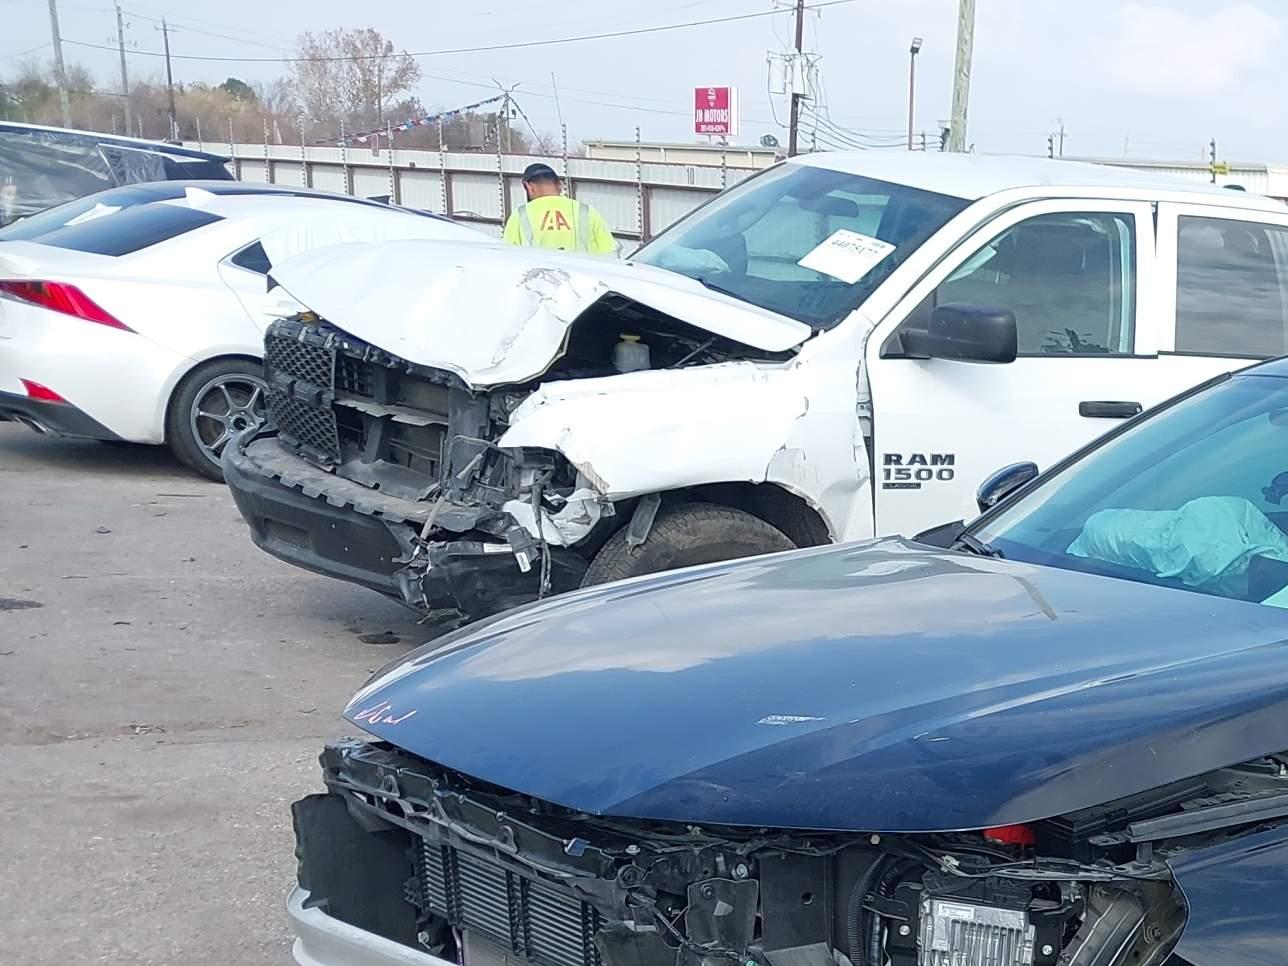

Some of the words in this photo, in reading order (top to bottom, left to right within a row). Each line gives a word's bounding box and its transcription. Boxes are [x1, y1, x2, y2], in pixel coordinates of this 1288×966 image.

[704, 109, 728, 123] MOTORS
[686, 167, 695, 185] 10
[883, 453, 955, 466] RAM
[883, 467, 955, 481] 1500
